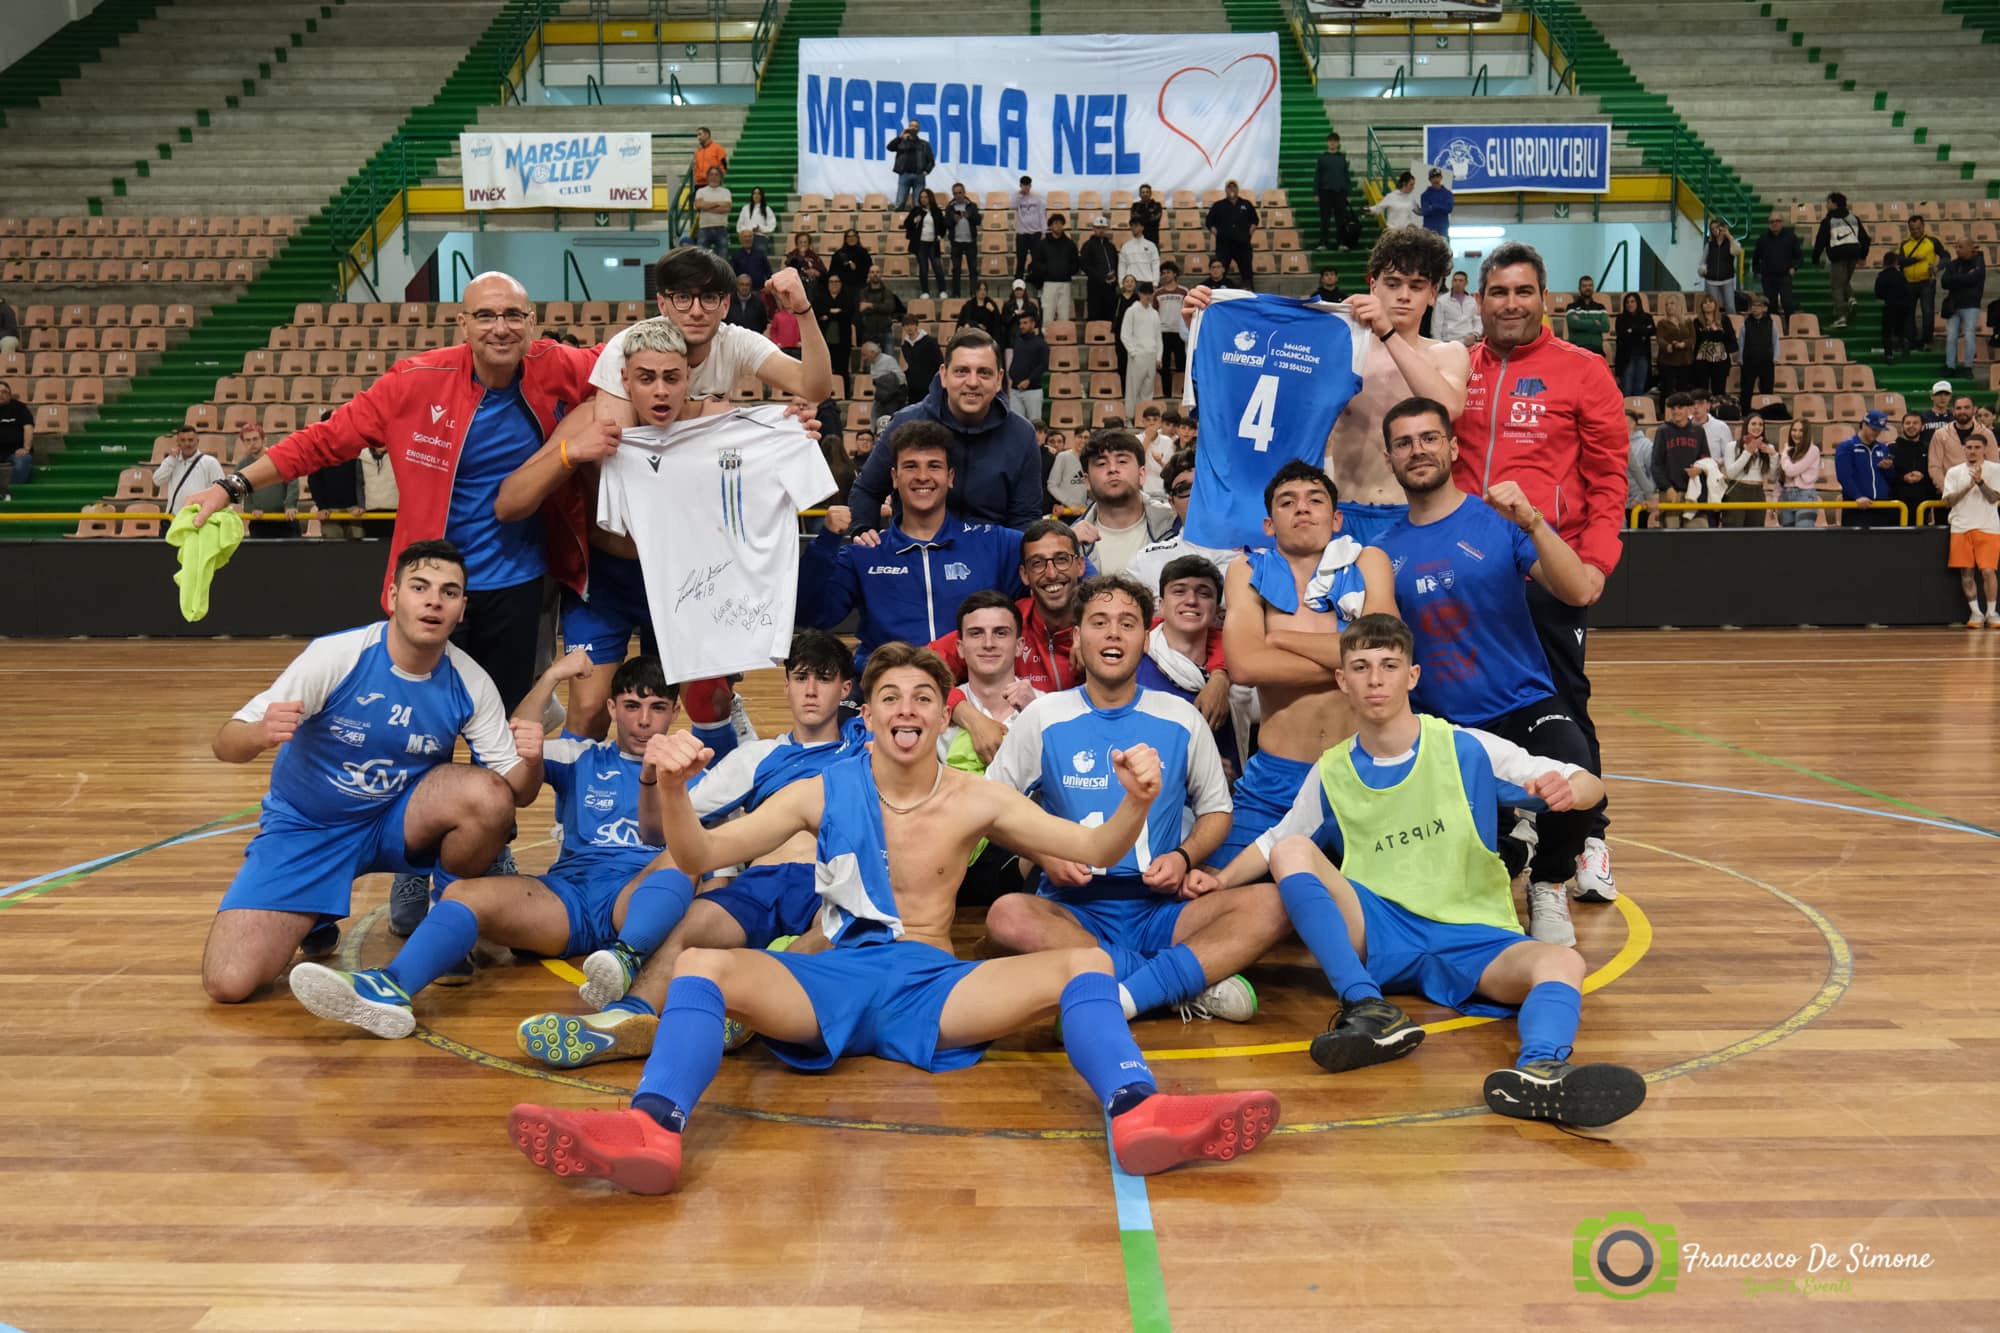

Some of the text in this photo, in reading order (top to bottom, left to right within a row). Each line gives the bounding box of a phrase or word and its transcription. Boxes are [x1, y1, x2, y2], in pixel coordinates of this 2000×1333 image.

[807, 74, 1141, 175] MARSALA NEL
[506, 135, 608, 169] MARSALA
[469, 187, 506, 201] IMEX
[559, 185, 592, 195] CLUB
[609, 187, 648, 201] IMEX
[1222, 351, 1266, 366] universal
[1238, 374, 1280, 452] 4
[867, 566, 909, 575] LEGEA
[387, 704, 413, 727] 24
[1062, 774, 1109, 788] universal
